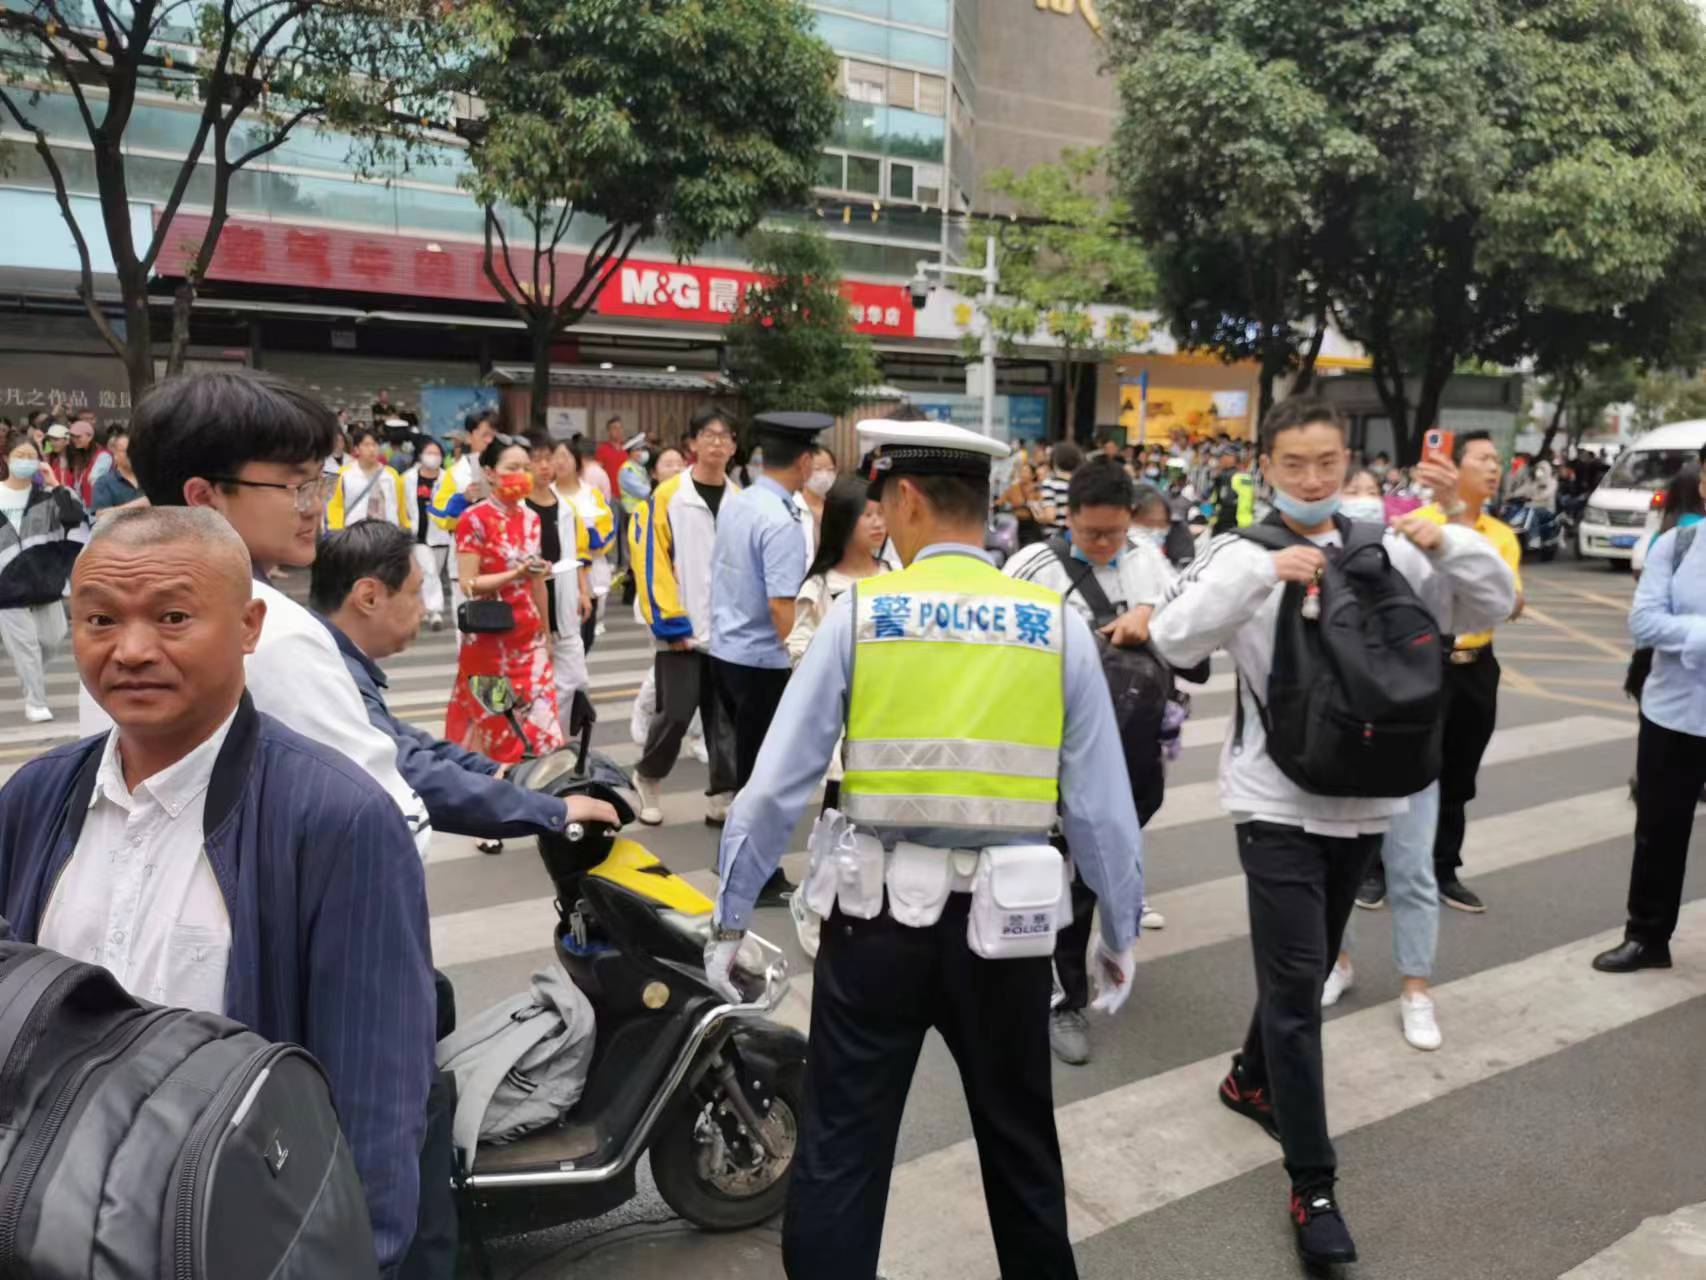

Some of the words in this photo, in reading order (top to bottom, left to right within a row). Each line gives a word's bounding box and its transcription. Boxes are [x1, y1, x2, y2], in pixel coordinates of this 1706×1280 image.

[621, 267, 700, 309] M&G
[0, 387, 89, 407] 凡之作品
[870, 595, 912, 638] 警
[919, 602, 1006, 632] POLICE
[1014, 603, 1050, 646] 察
[1003, 923, 1050, 934] POLICE
